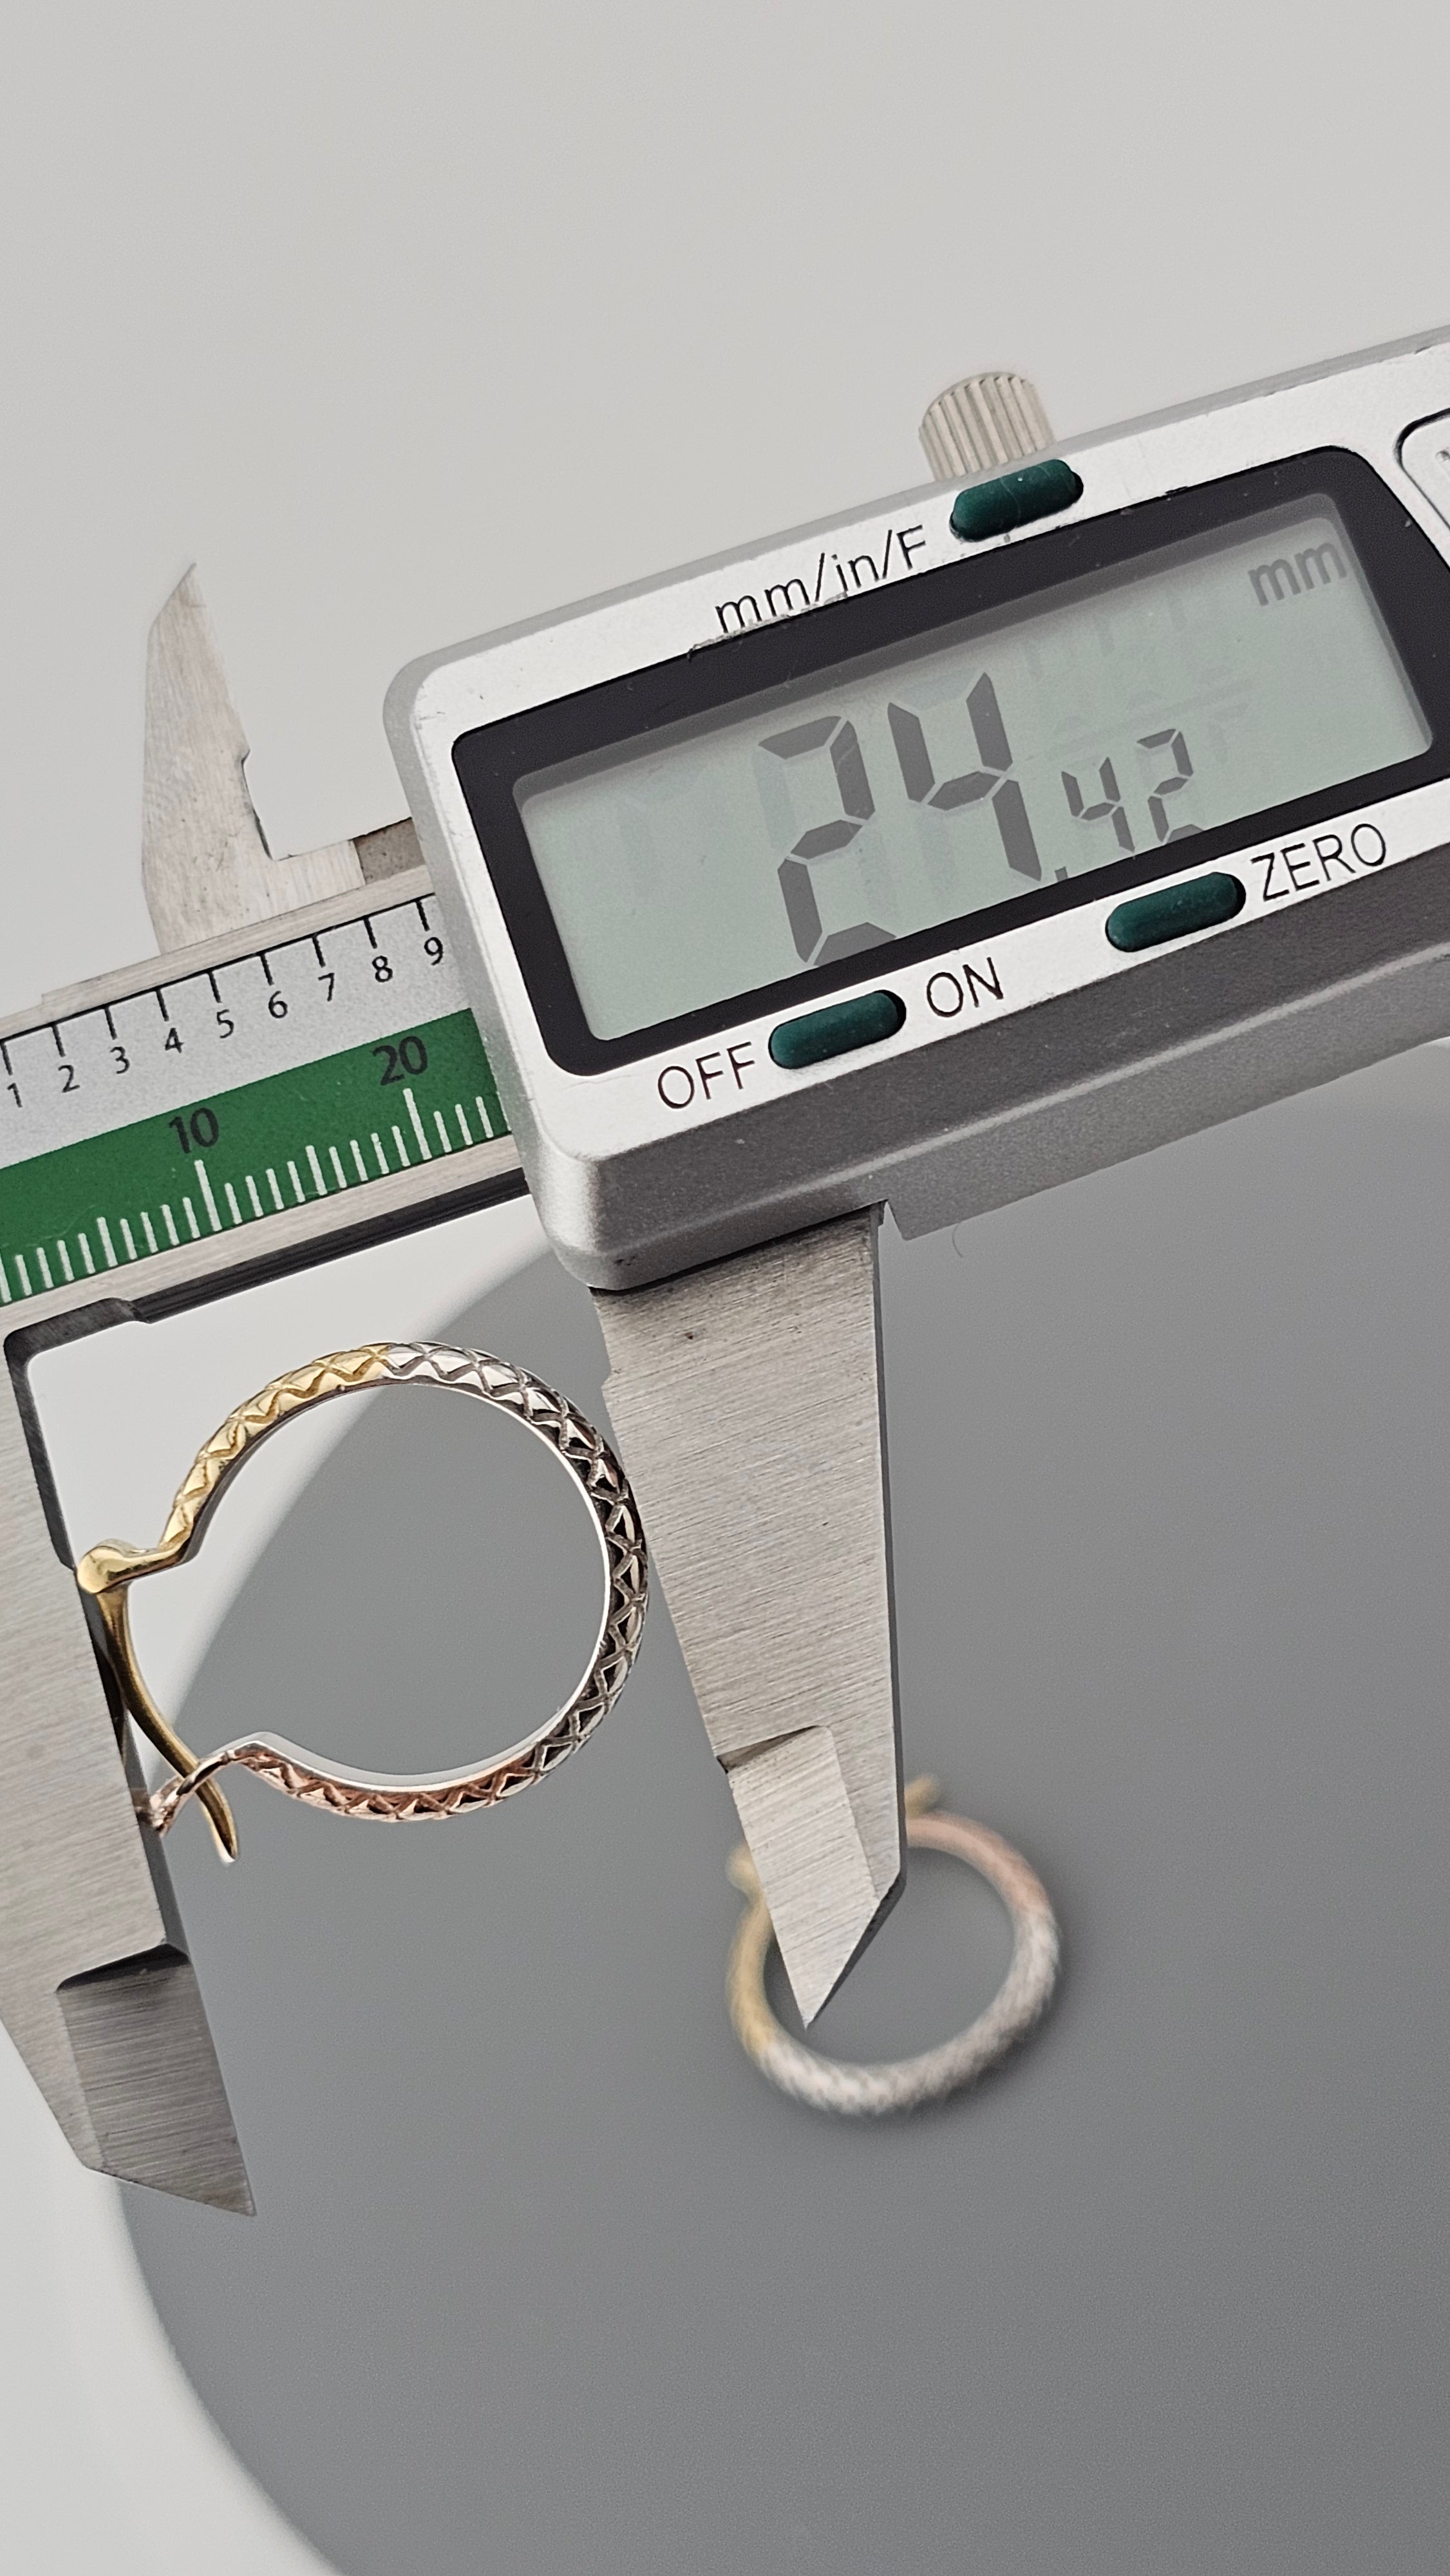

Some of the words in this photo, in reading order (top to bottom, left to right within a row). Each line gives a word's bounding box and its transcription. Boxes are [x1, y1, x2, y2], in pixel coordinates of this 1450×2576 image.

[715, 524, 926, 634] mm/in/F
[1248, 542, 1348, 606] mm
[1250, 823, 1387, 902] ZERO
[7, 1083, 23, 1108] 1
[58, 1065, 80, 1093] 2
[110, 1046, 129, 1074] 3
[165, 1028, 184, 1053] 4
[216, 1010, 234, 1038] 5
[268, 991, 288, 1019] 6
[318, 973, 335, 1001] 7
[373, 956, 392, 983] 8
[423, 937, 443, 965] 9
[926, 957, 1004, 1018] ON
[169, 1106, 220, 1154] 10
[372, 1036, 428, 1086] 20
[657, 1041, 756, 1110] OFF
